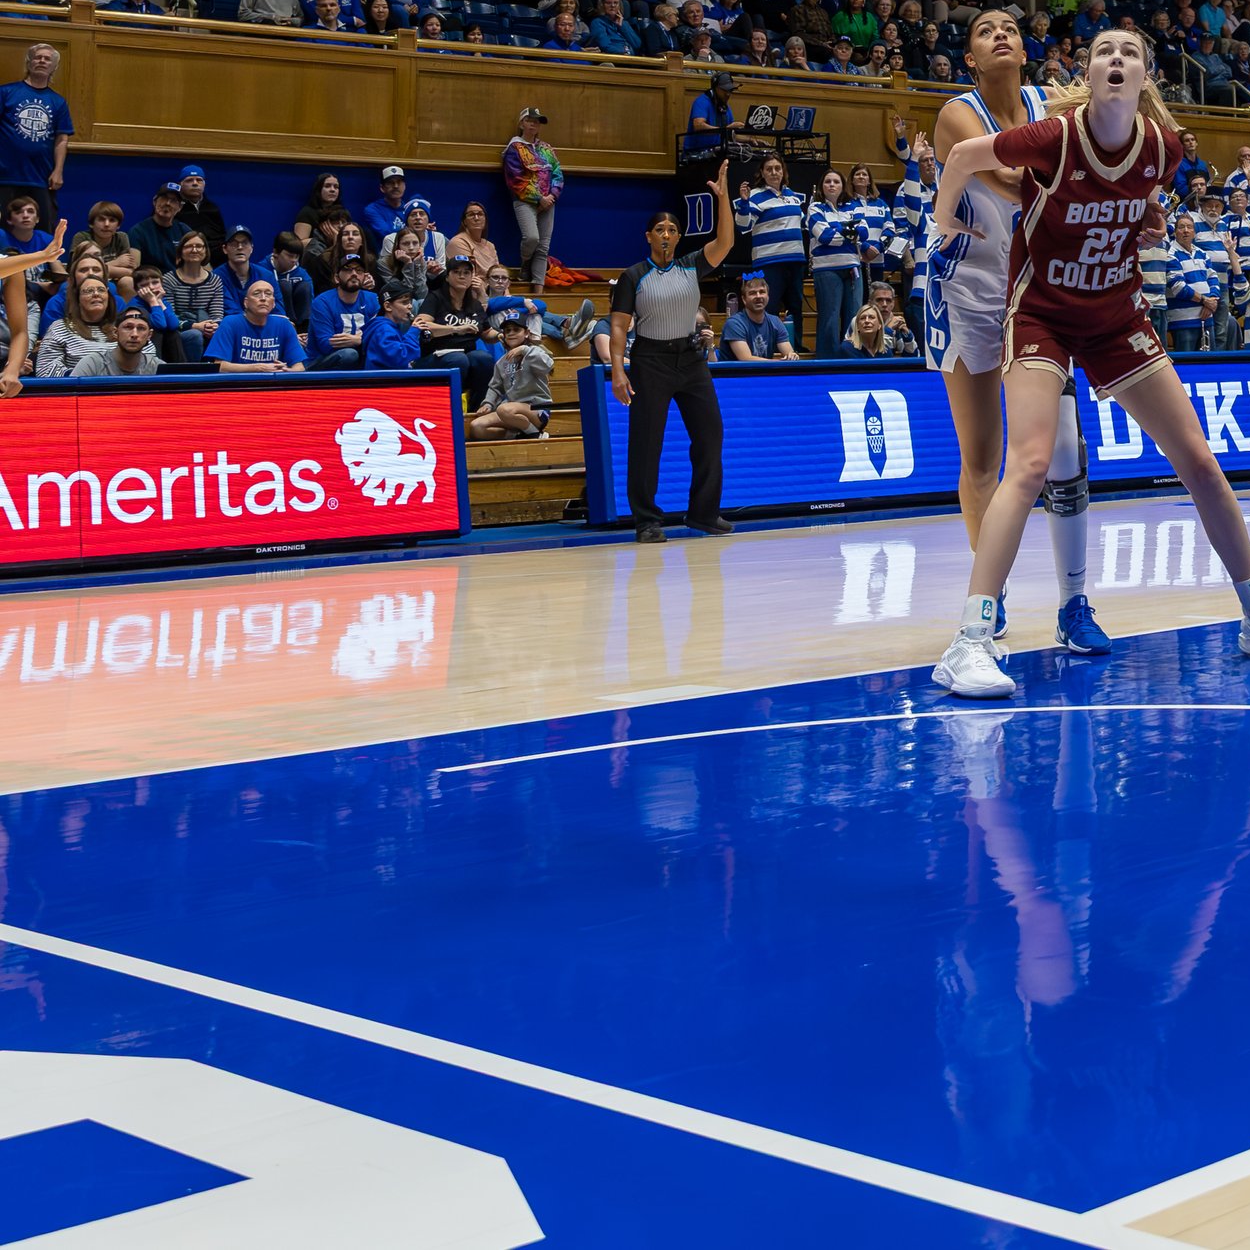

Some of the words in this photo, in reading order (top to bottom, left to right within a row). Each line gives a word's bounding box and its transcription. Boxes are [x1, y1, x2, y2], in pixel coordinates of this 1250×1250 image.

[1078, 227, 1130, 265] 23
[1047, 255, 1135, 291] COLLEGE
[444, 314, 479, 333] Duke
[240, 348, 279, 362] CAROLINA
[810, 501, 846, 509] DAKTRONICS
[255, 543, 306, 554] DAKTRONICS
